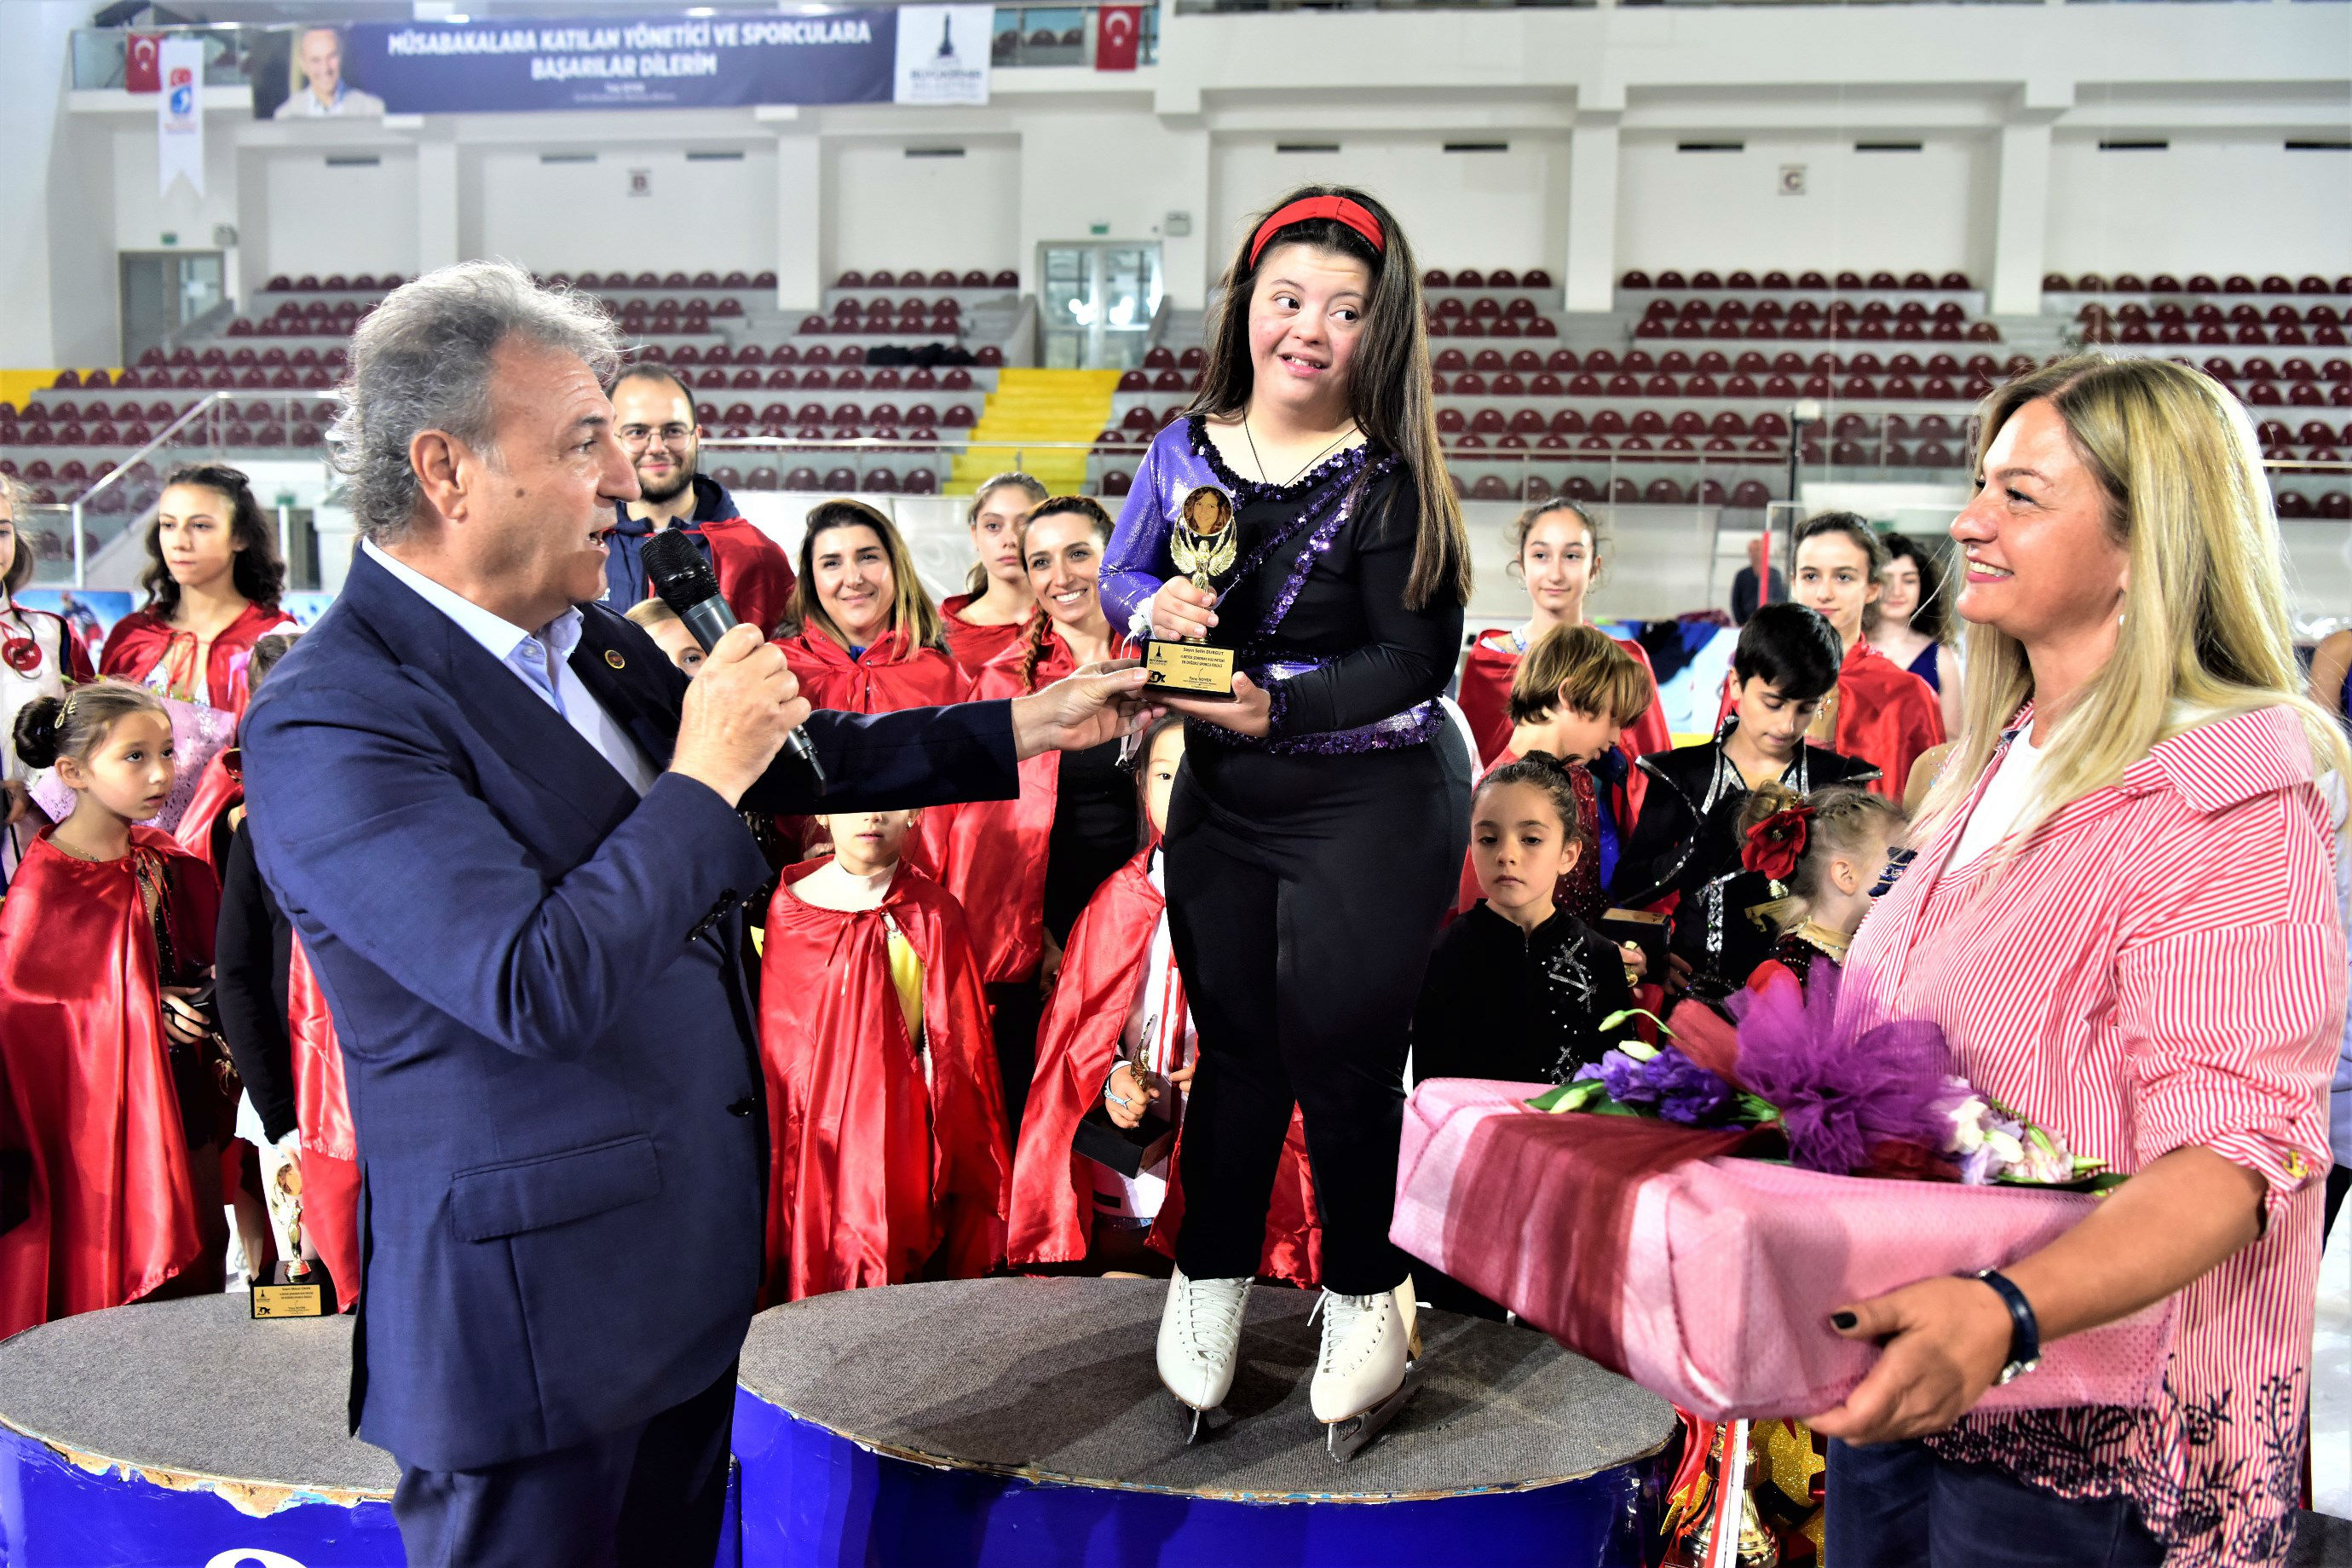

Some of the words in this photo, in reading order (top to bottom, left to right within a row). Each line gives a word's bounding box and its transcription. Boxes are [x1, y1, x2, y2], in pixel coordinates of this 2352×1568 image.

[540, 27, 620, 51] KATILAN
[713, 23, 738, 46] VE
[741, 20, 872, 44] SPORCULARA
[530, 55, 637, 81] BAŞARILAR
[1783, 171, 1801, 191] C
